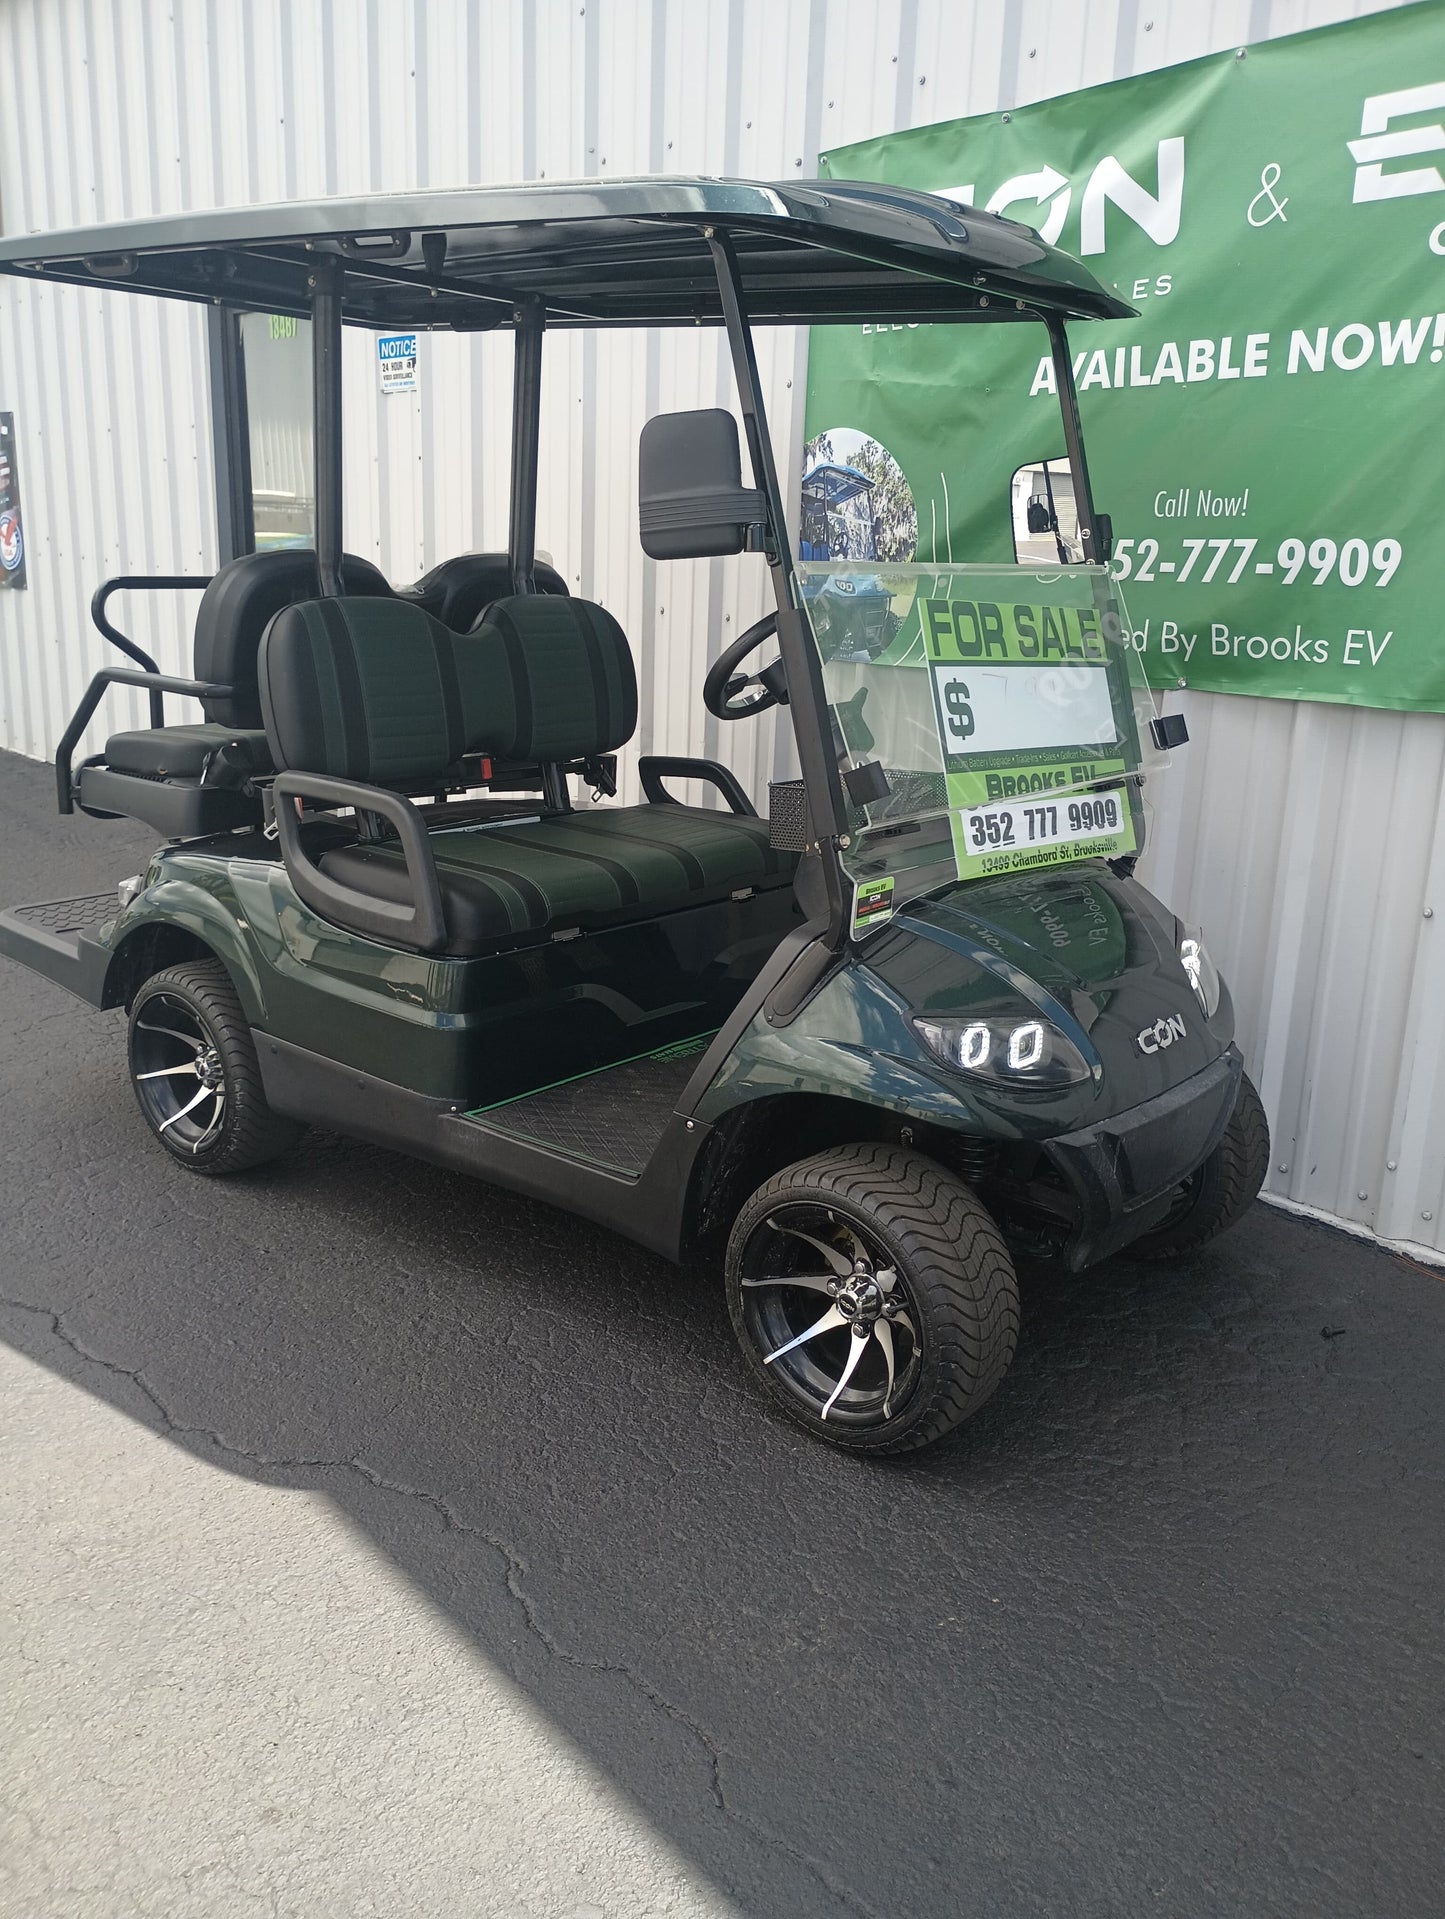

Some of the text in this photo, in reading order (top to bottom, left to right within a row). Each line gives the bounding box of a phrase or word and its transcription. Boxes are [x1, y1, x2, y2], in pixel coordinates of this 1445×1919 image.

[928, 136, 1185, 256] ON
[1247, 162, 1290, 228] &
[381, 340, 416, 358] NOTICE
[1287, 313, 1445, 375] NOW!
[1154, 488, 1249, 519] Call Now!
[1110, 538, 1402, 588] 52-777-9909
[926, 599, 1009, 658] FOR
[1013, 604, 1103, 659] SALE
[1120, 618, 1150, 653] ed
[1161, 621, 1197, 662] By
[1211, 624, 1329, 664] Brooks
[1343, 629, 1393, 667] EV
[944, 677, 976, 741] $
[970, 798, 1118, 848] 352 777 9909
[1012, 847, 1058, 868] Chambord
